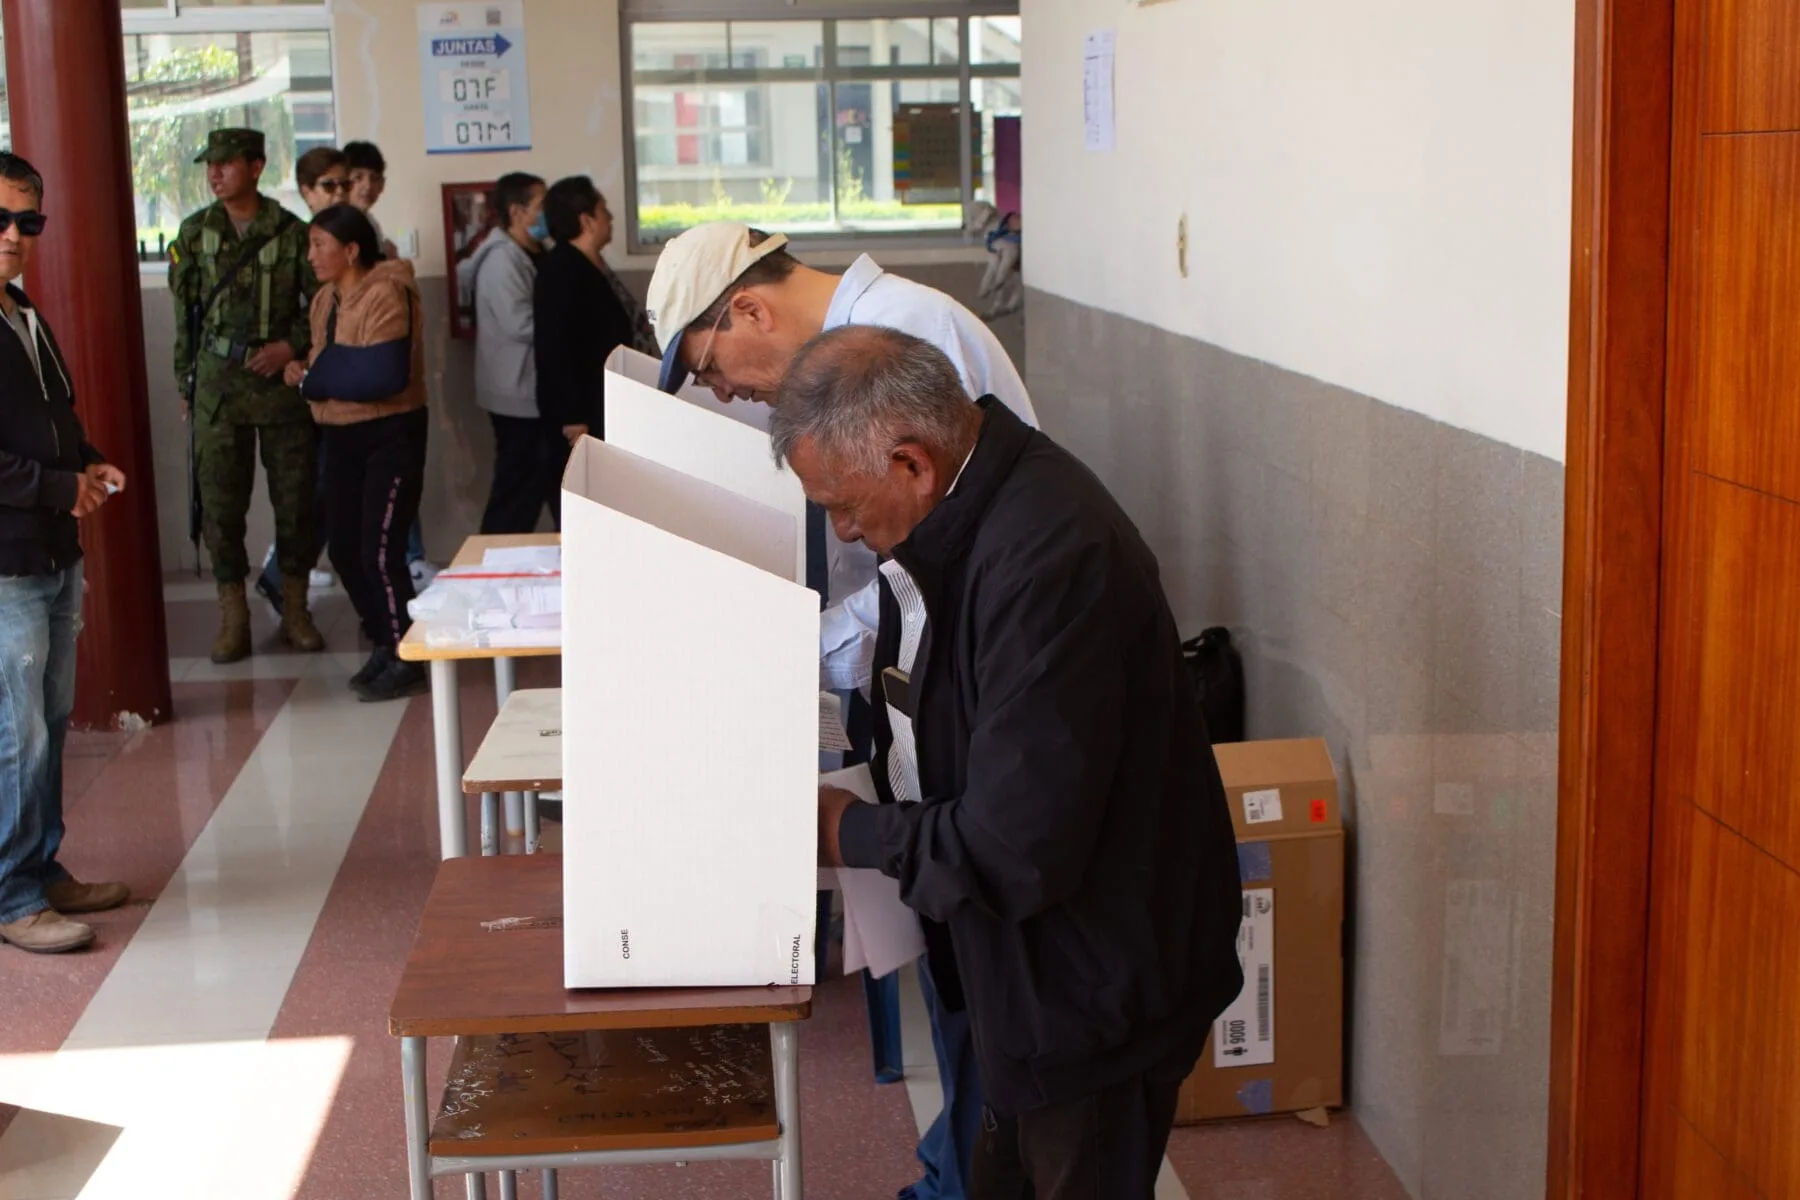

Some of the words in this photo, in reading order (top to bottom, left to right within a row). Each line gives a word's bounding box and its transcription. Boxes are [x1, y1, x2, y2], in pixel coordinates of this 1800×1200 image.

[435, 39, 495, 54] JUNTAS
[453, 77, 496, 101] 07F
[456, 121, 511, 144] 07M
[621, 929, 630, 959] CONSE
[791, 934, 801, 984] ELECTORAL
